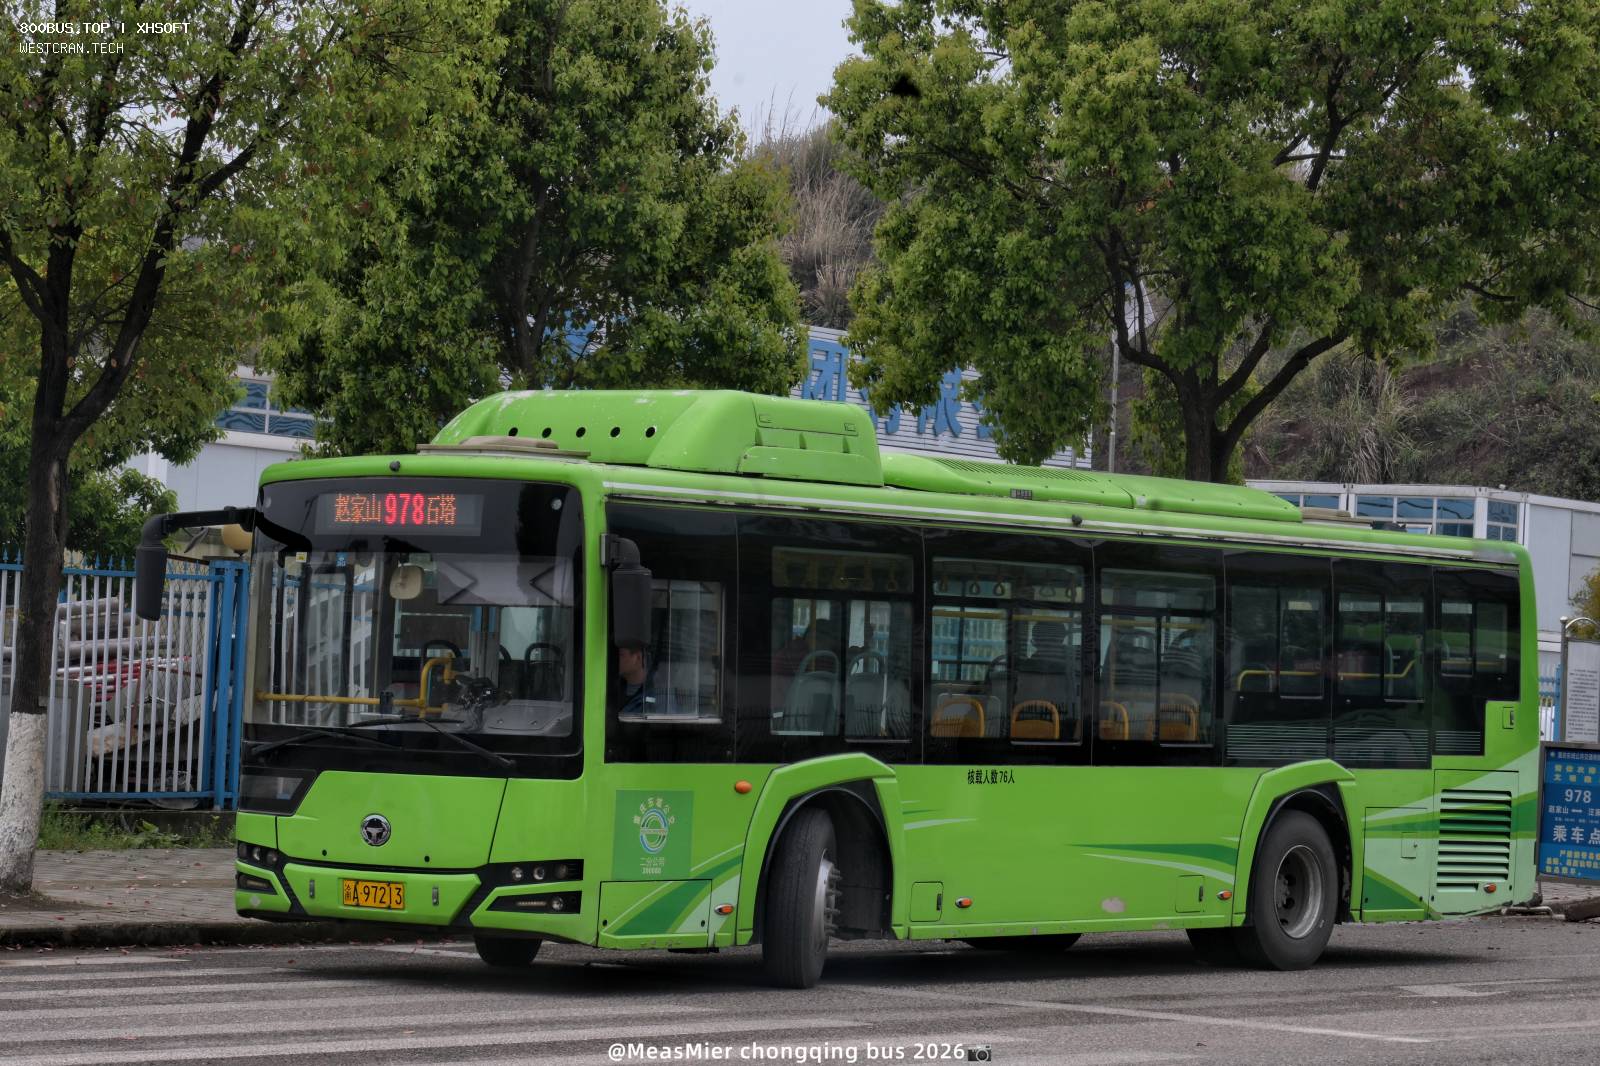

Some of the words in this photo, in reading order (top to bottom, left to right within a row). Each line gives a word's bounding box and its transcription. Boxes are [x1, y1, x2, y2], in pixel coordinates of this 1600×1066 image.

[384, 493, 425, 525] 978
[967, 769, 1015, 784] 核载人数76人
[1565, 789, 1591, 803] 978
[1552, 825, 1600, 845] 乘车点
